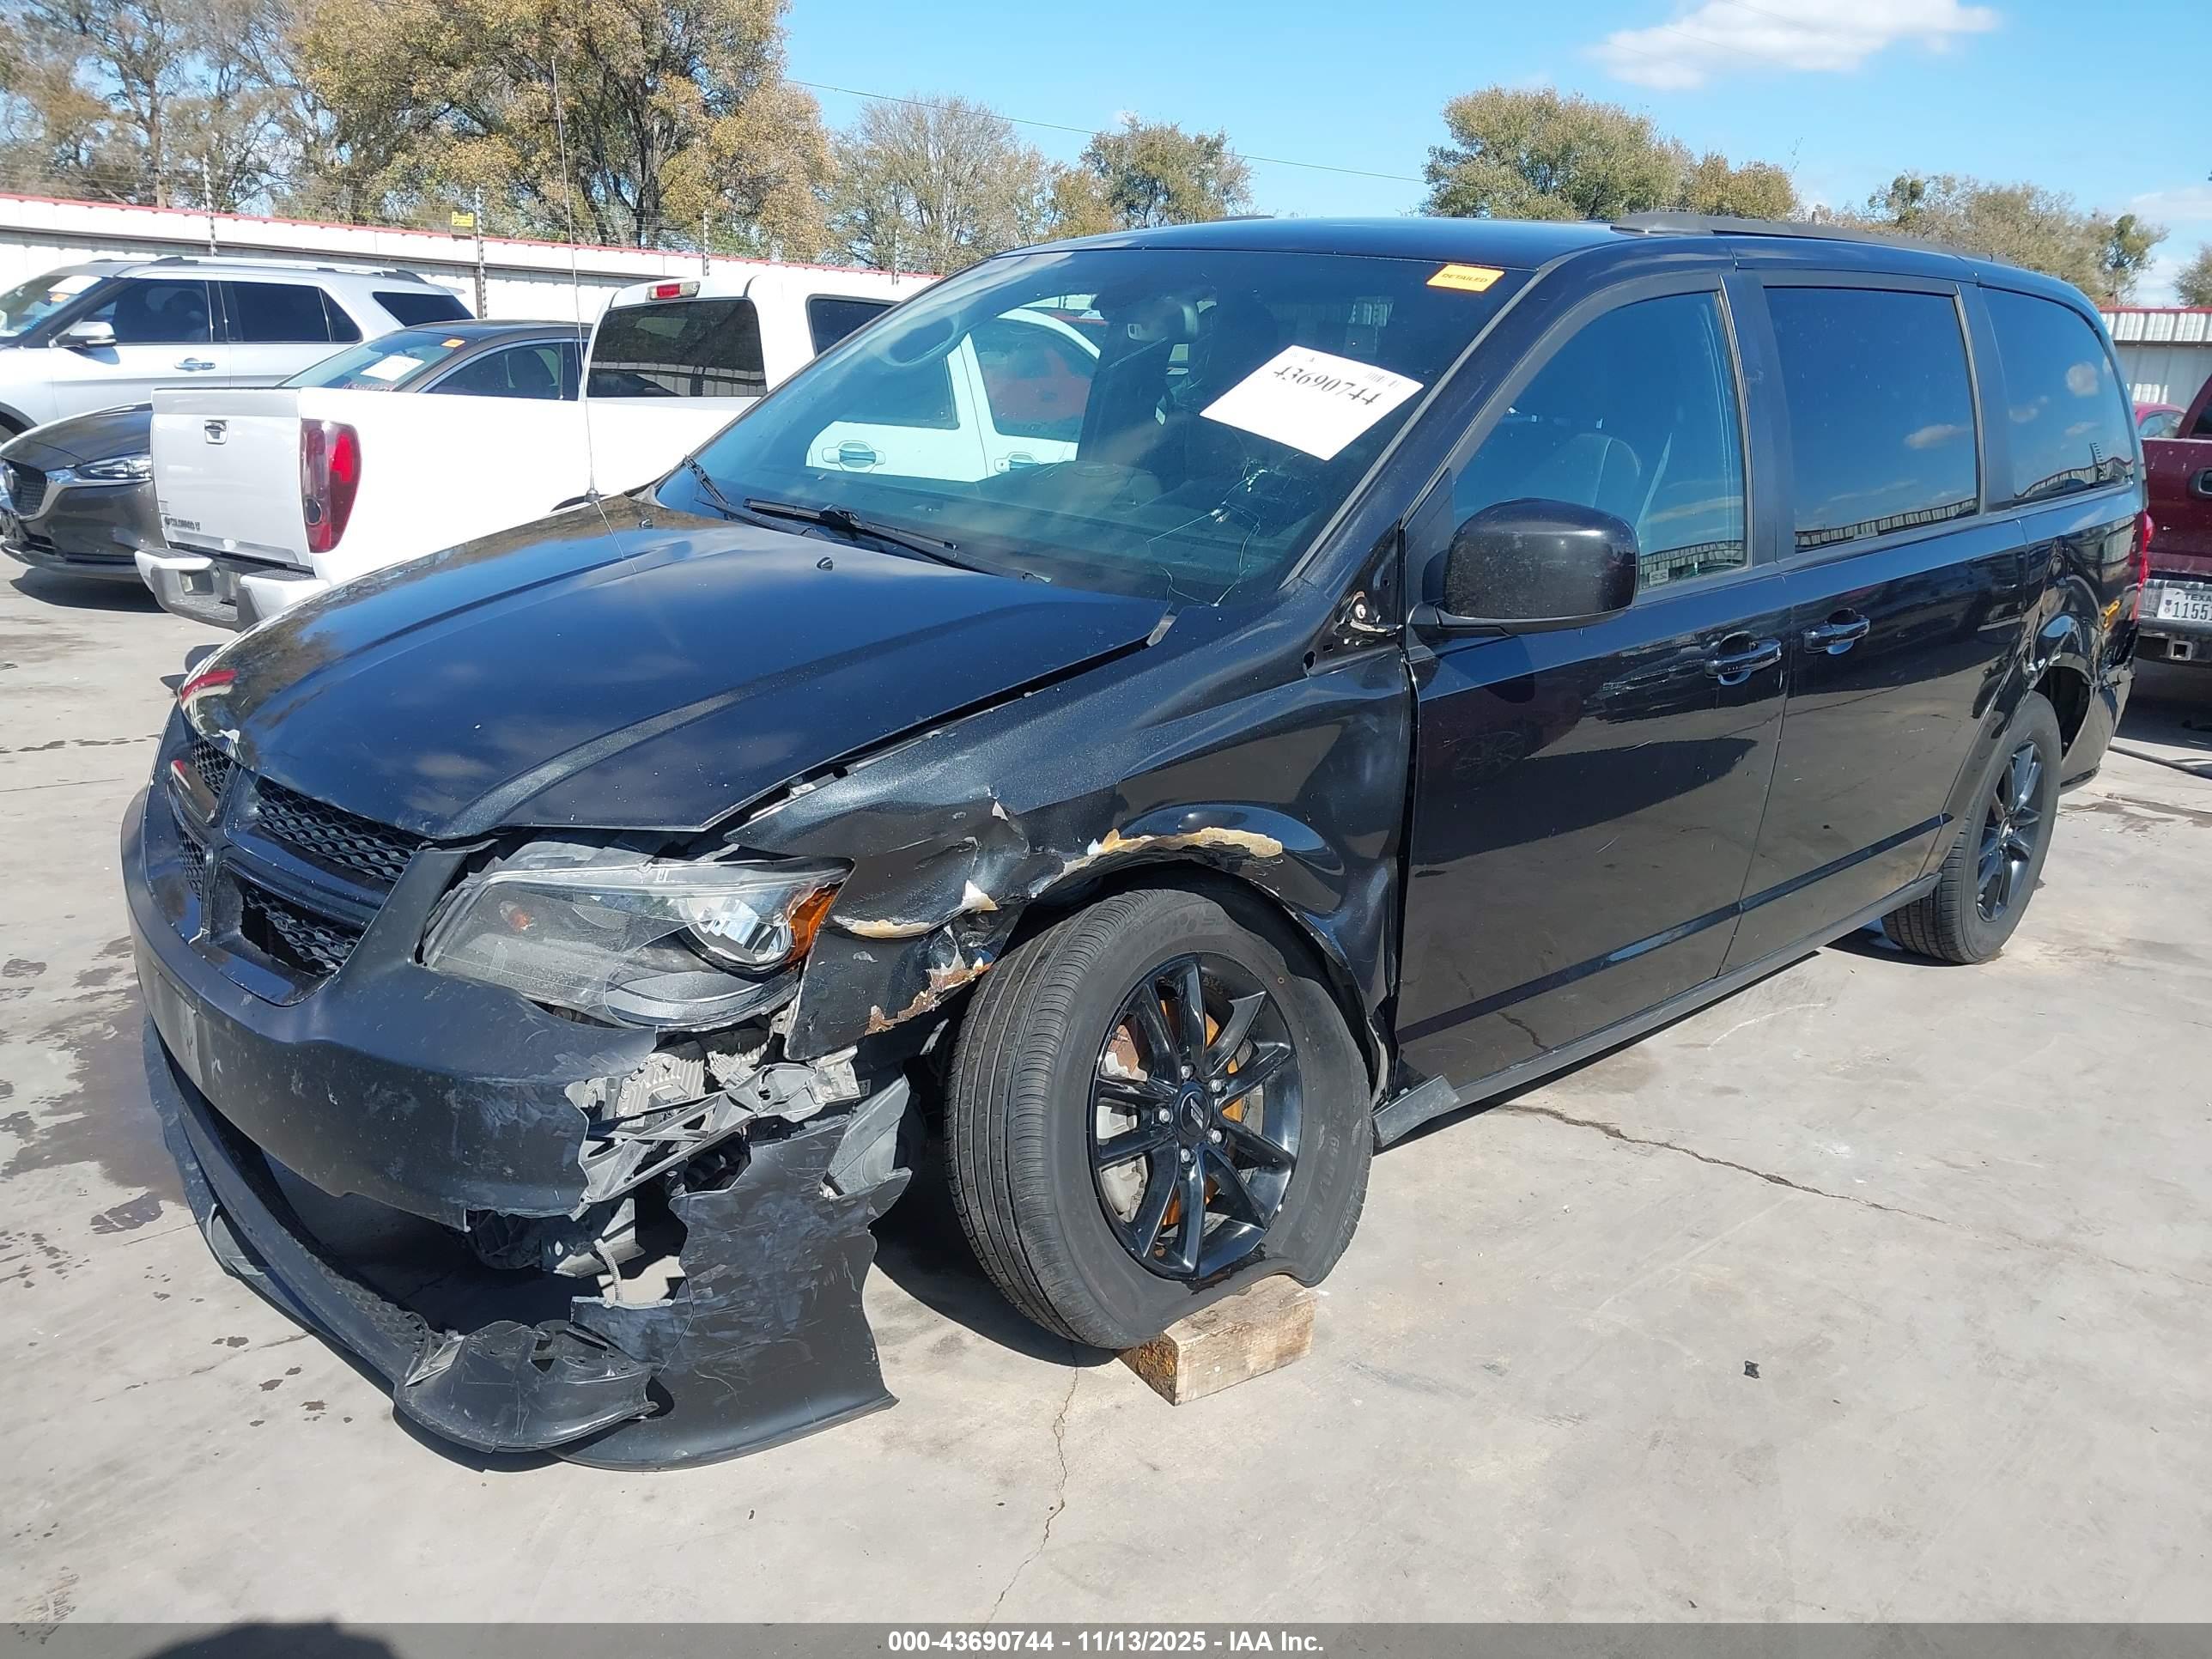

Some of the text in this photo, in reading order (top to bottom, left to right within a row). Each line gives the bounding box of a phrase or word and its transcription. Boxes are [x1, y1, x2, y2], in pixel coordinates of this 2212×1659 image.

[1442, 273, 1488, 283] DETAILED
[1273, 365, 1382, 406] 43690744
[2172, 601, 2212, 620] 1155
